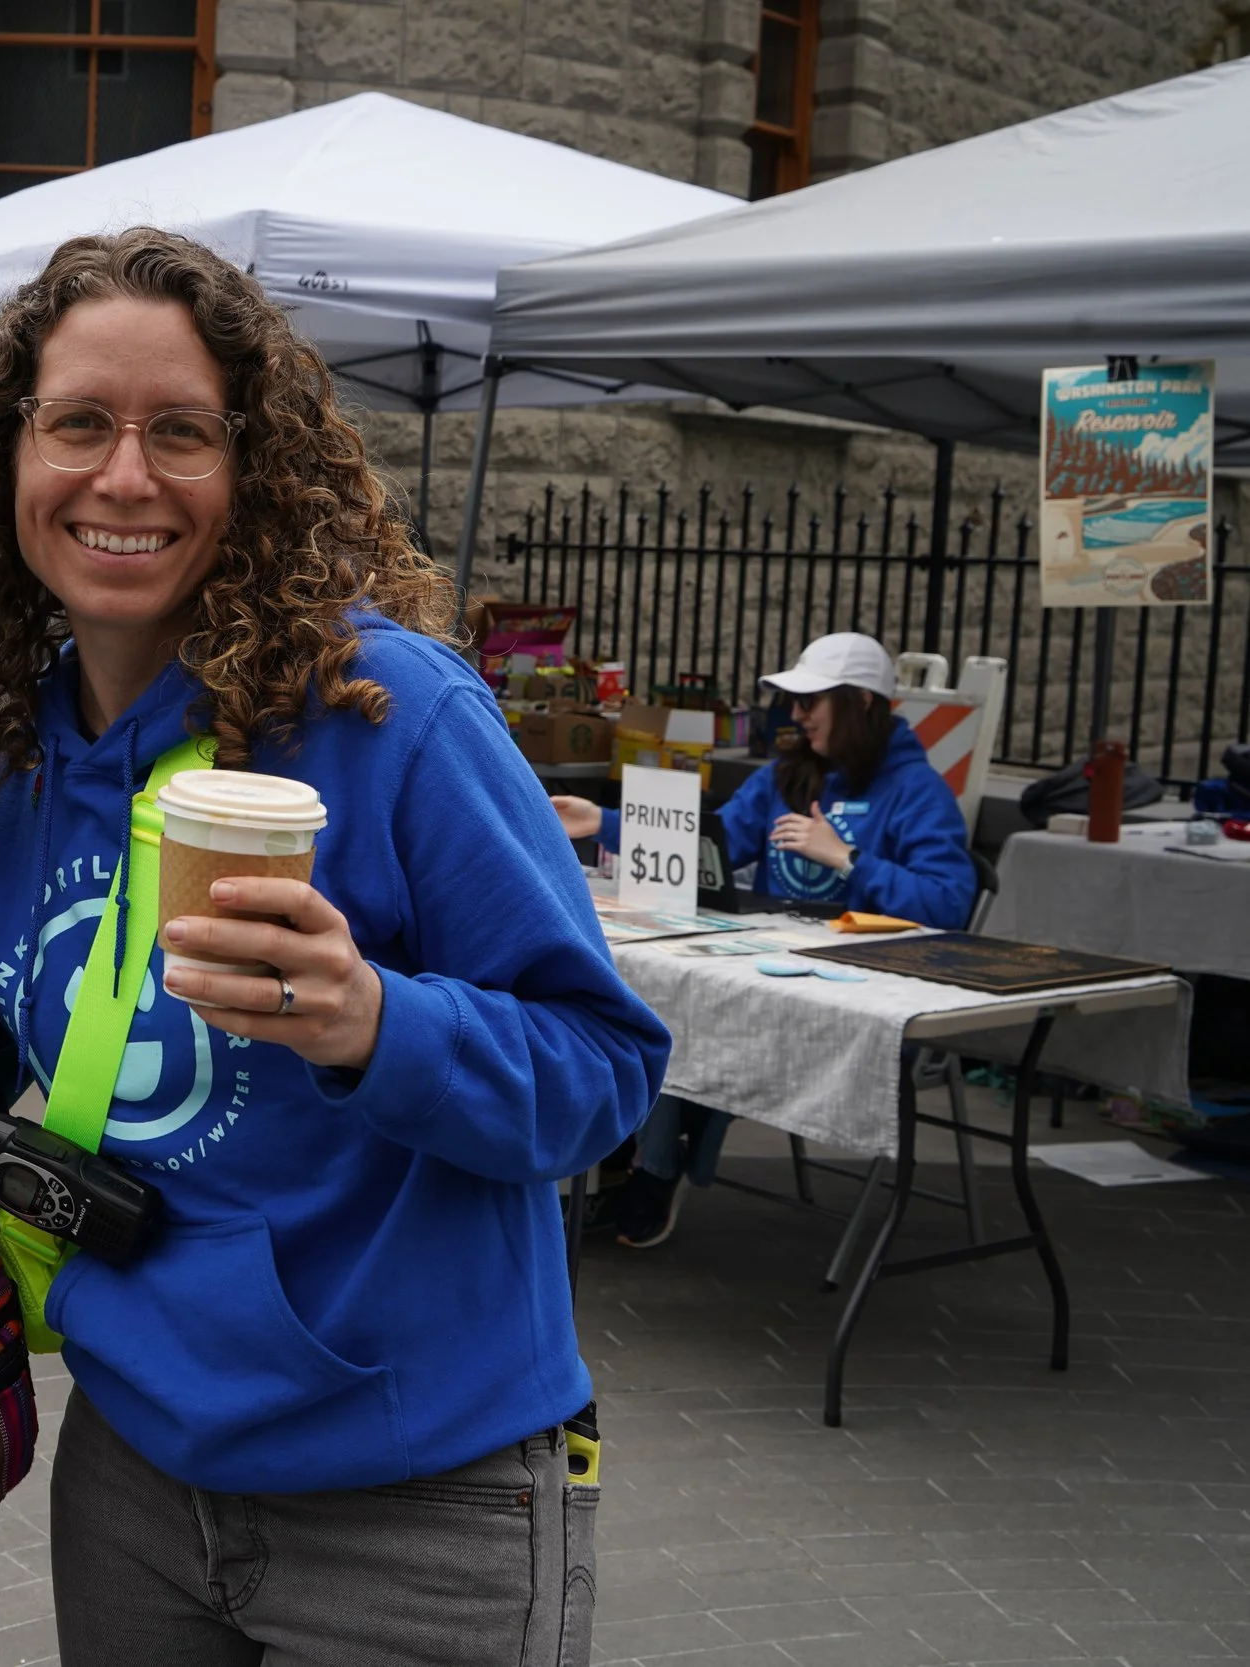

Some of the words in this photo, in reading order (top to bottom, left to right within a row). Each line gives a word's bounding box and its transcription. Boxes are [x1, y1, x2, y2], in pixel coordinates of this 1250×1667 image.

[1055, 379, 1156, 401] WASHINGTON
[1160, 379, 1203, 394] PARK
[1074, 409, 1178, 433] Reservoir
[625, 802, 696, 833] PRINTS
[630, 843, 685, 887] $10
